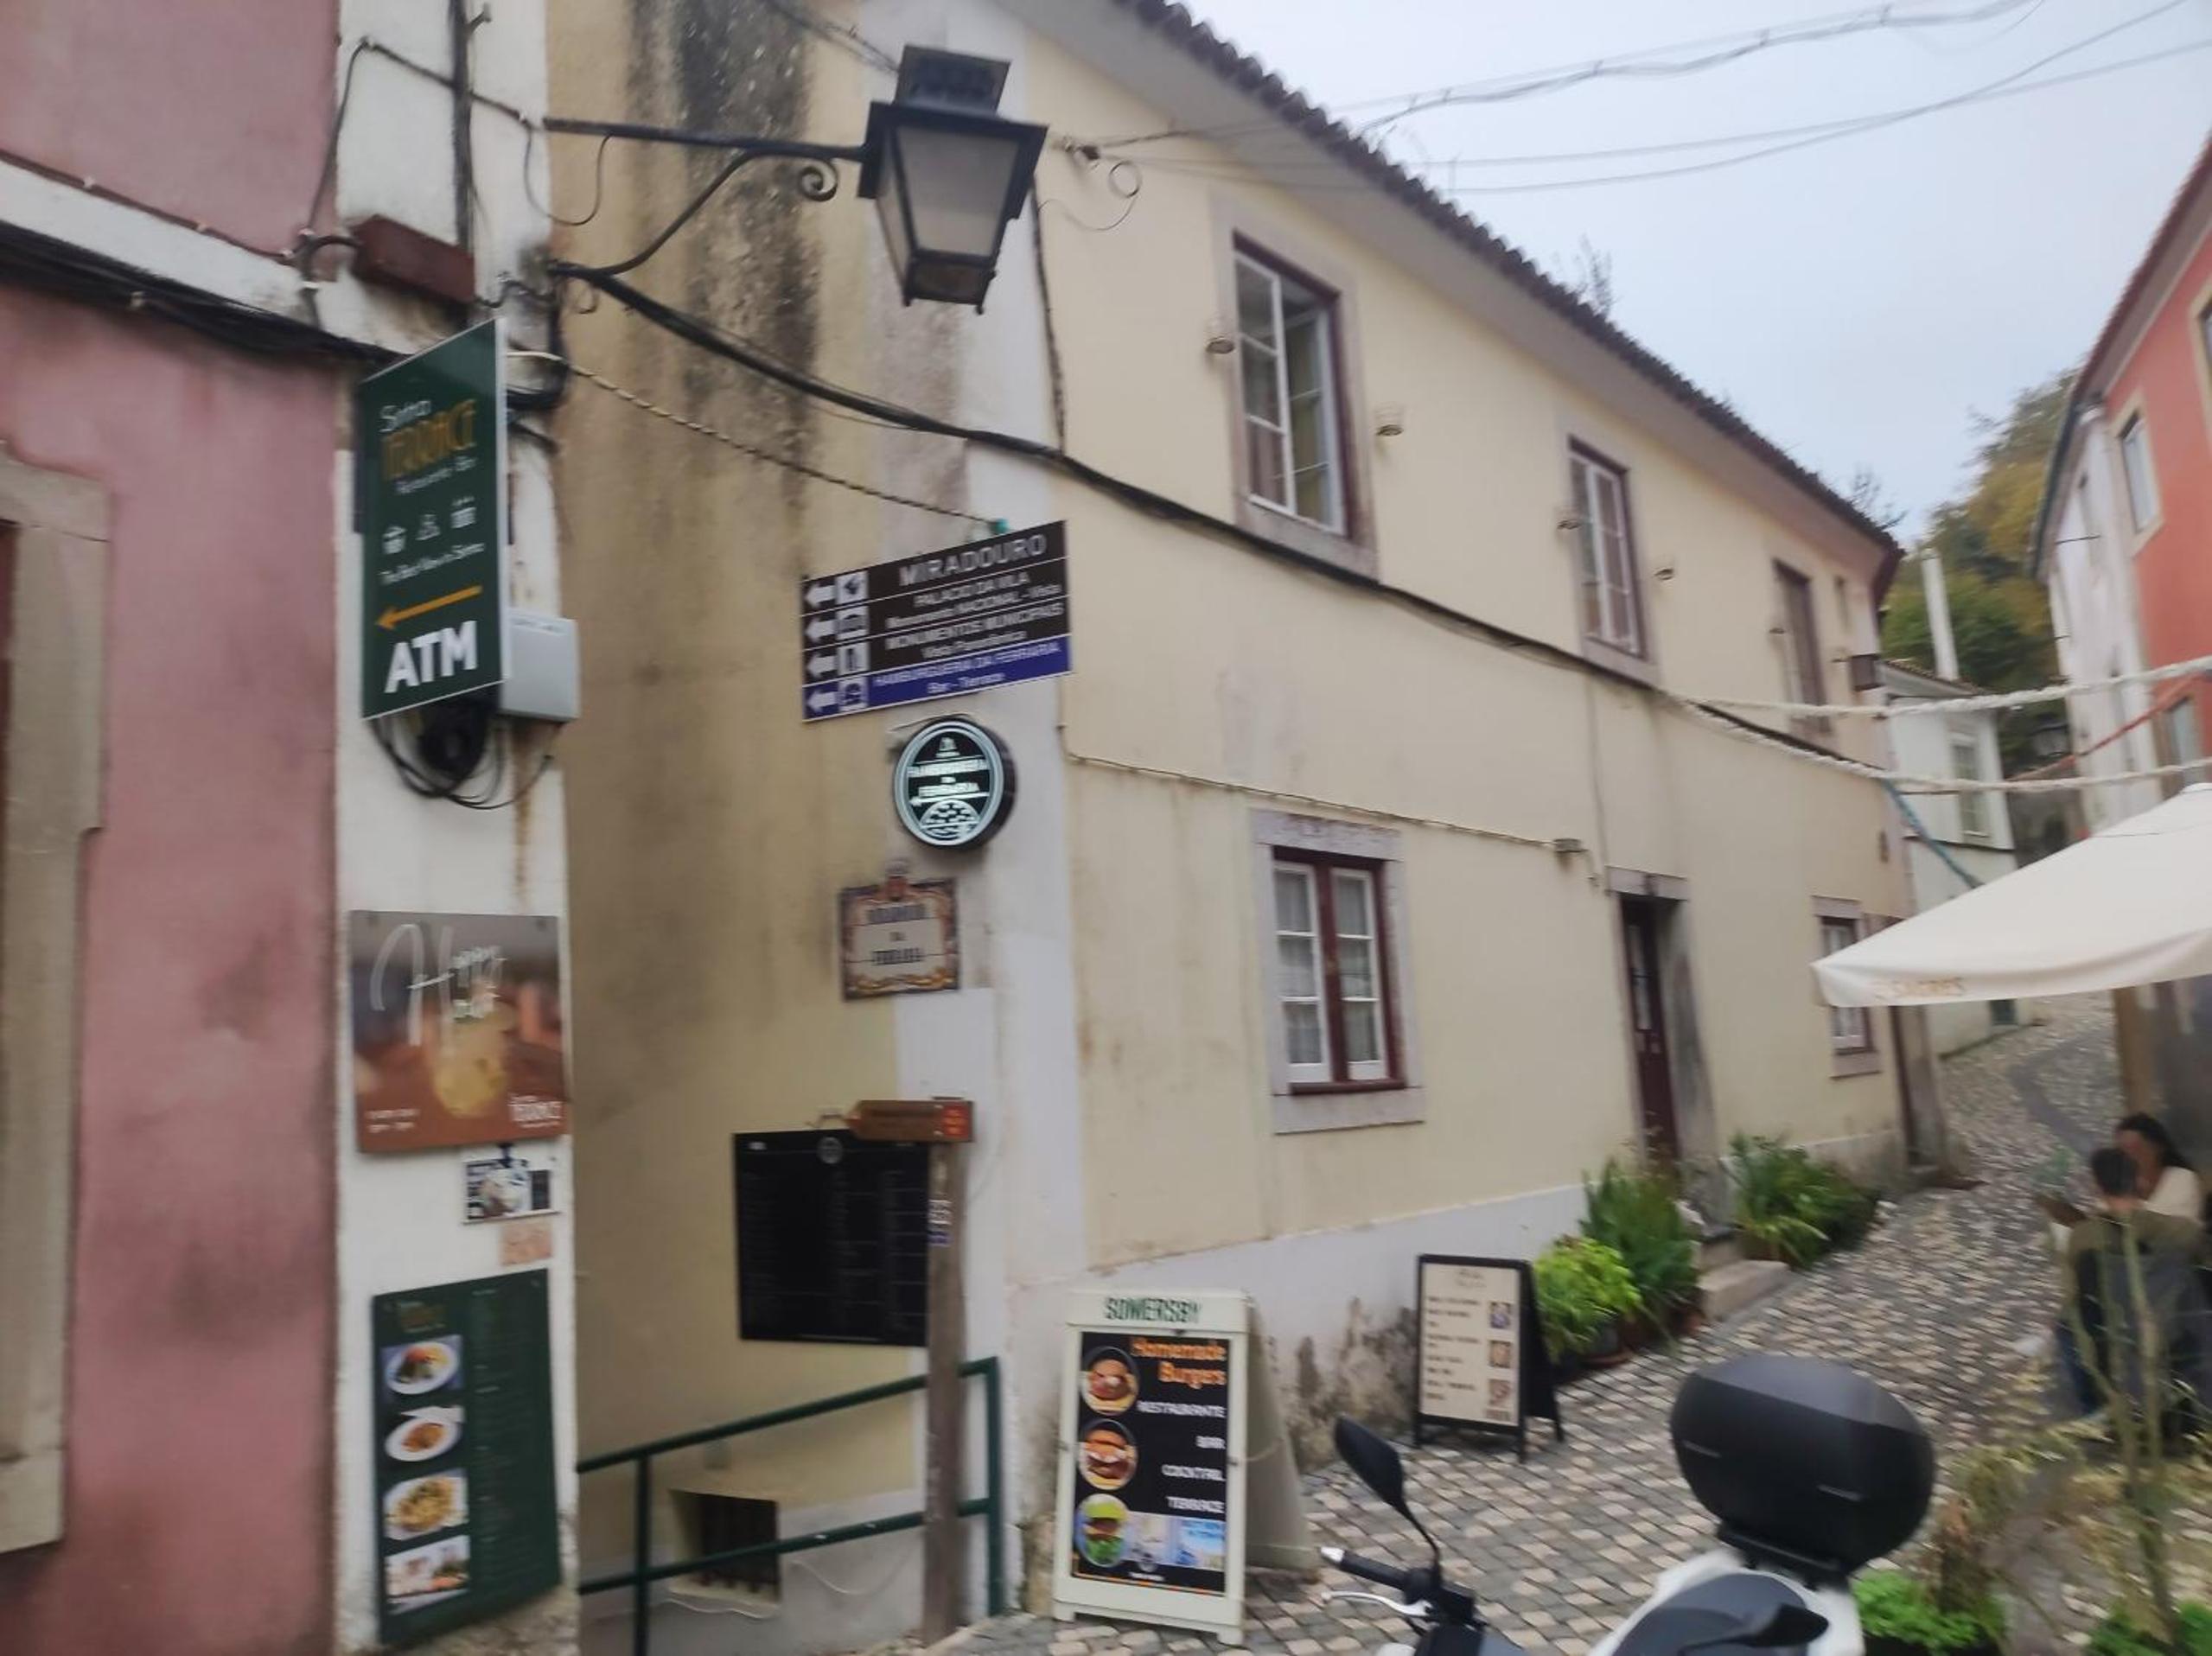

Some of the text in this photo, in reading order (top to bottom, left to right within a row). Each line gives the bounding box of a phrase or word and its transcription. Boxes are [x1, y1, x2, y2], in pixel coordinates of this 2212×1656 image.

[899, 534, 1048, 586] MIRADOURO
[385, 620, 478, 693] ATM
[1105, 1297, 1200, 1323] SOMERSBY
[1159, 1360, 1227, 1390] Burgers
